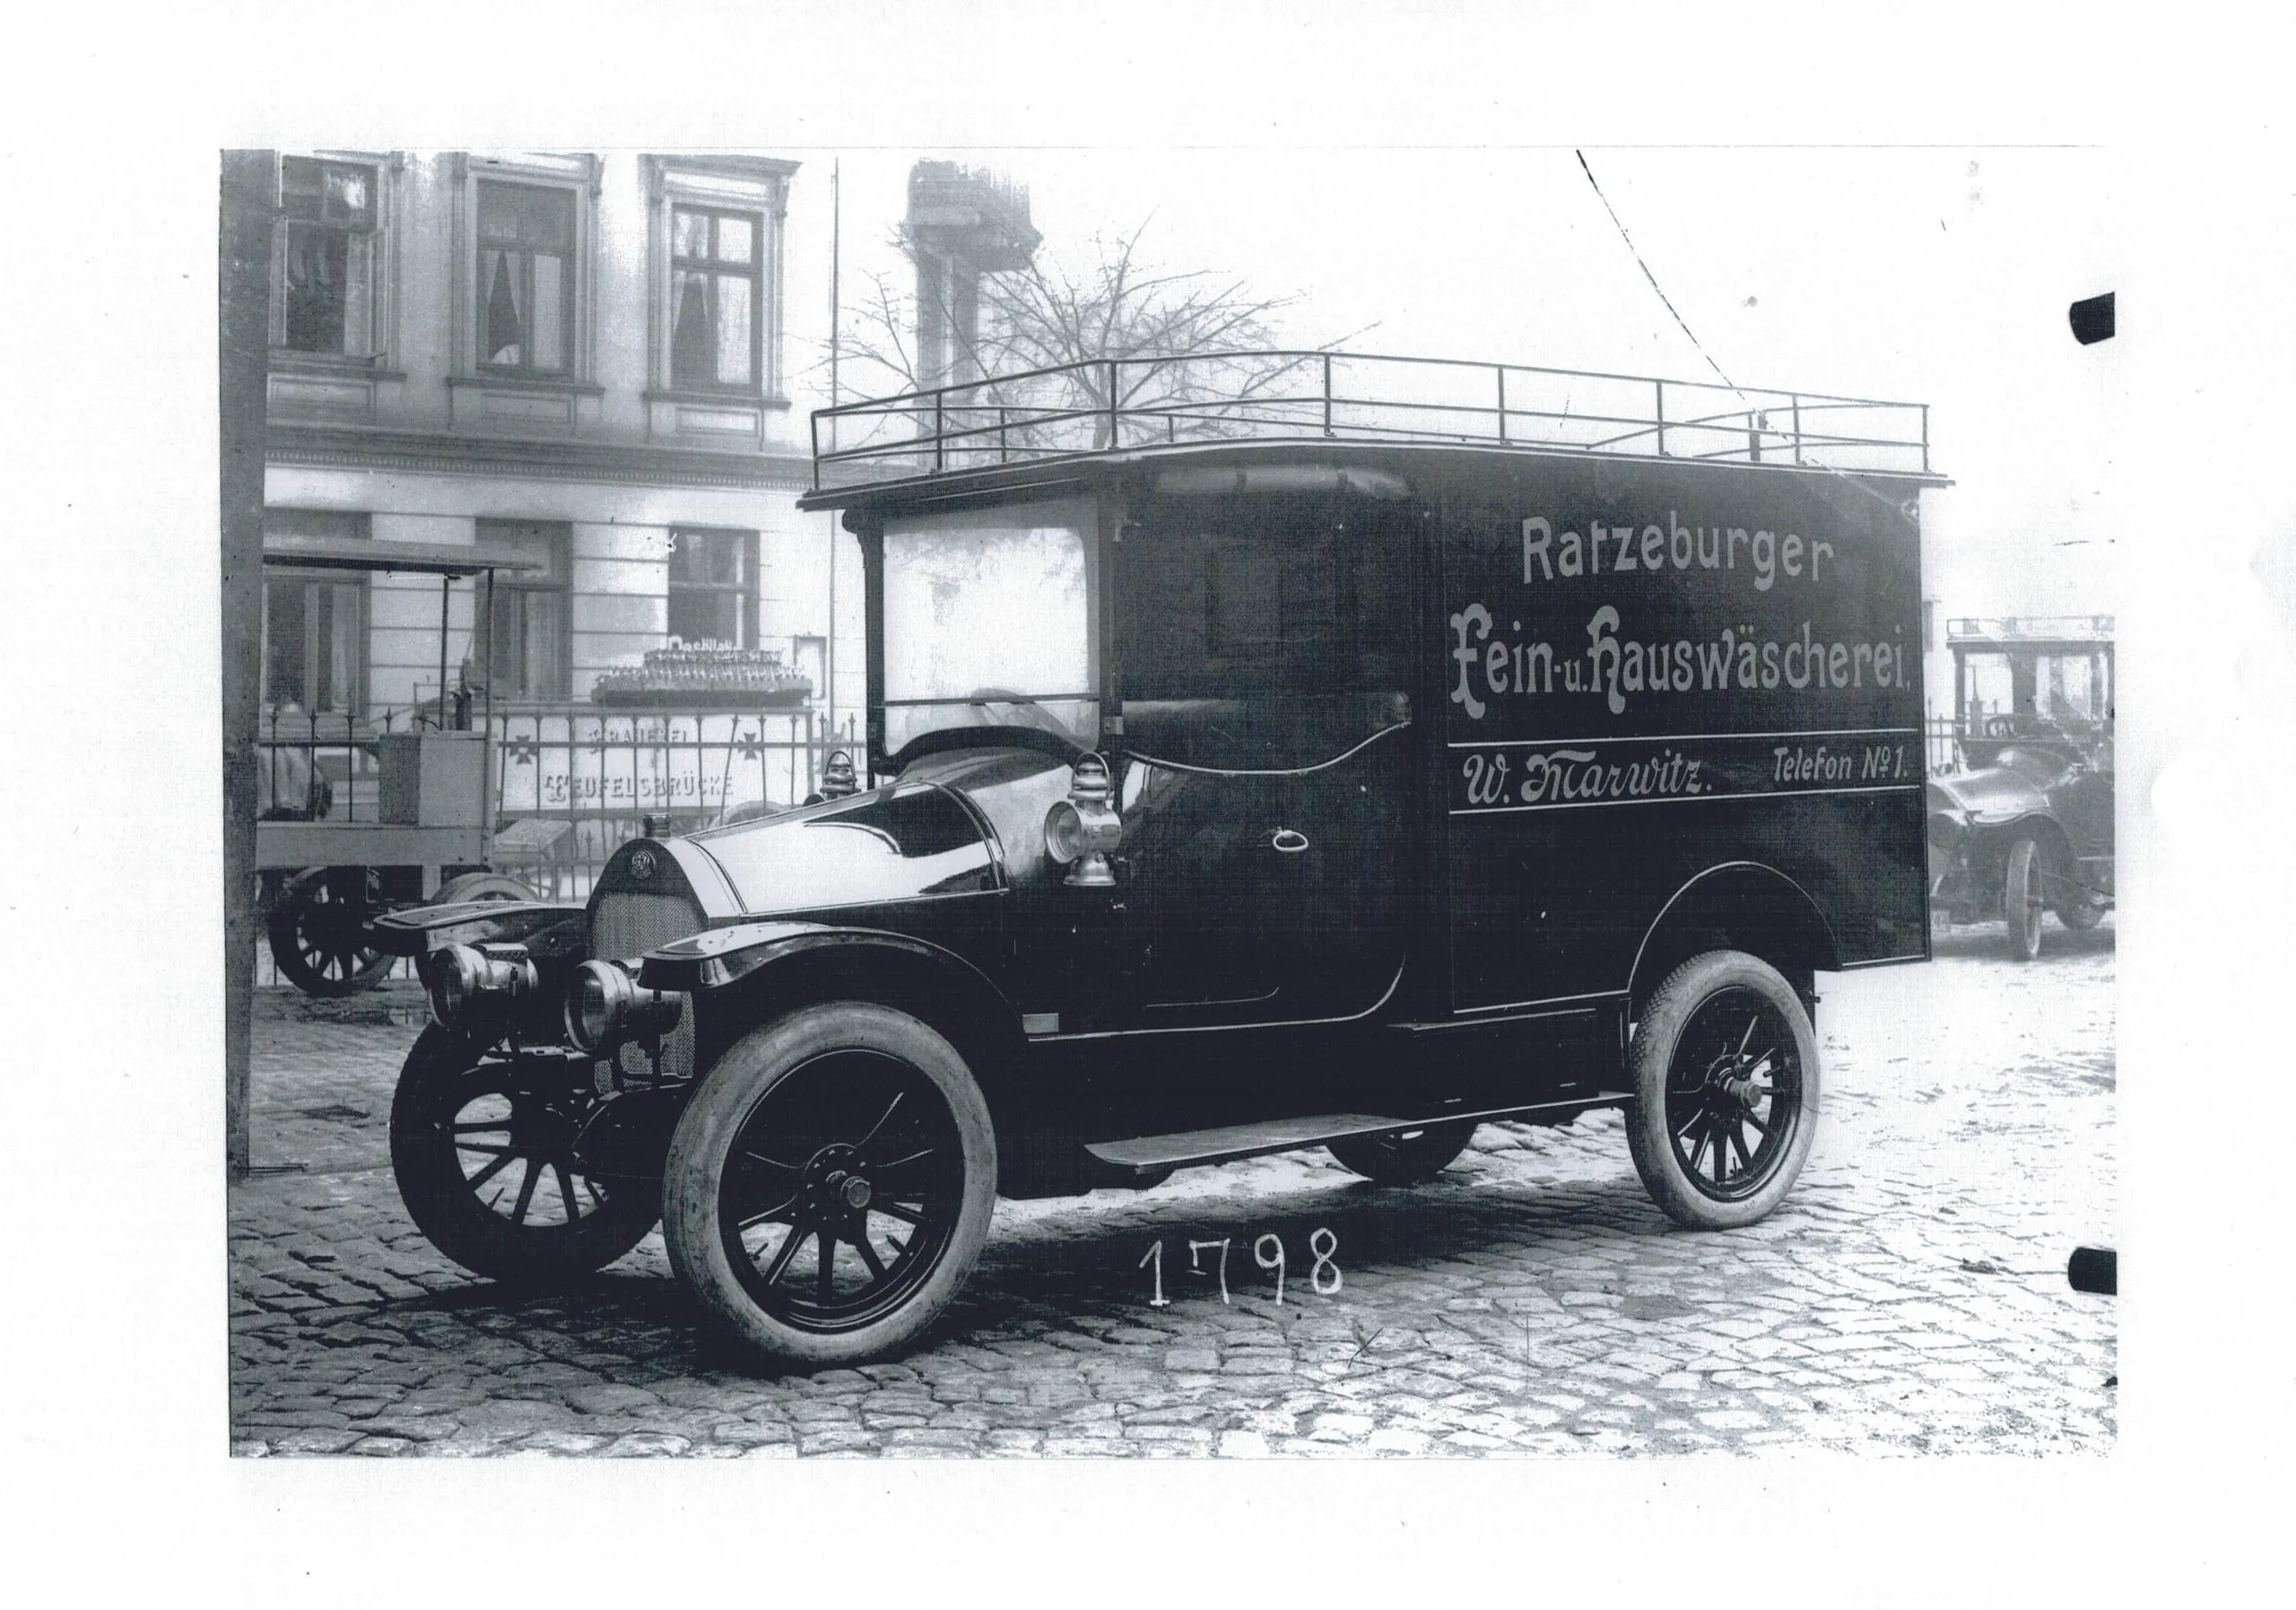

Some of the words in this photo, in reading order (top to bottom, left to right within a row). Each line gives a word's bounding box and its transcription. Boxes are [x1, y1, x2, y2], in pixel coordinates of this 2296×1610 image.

[1522, 510, 1834, 591] Ratzeburger
[1463, 753, 1510, 805] W.
[1520, 748, 1712, 803] Marwitz.
[1773, 746, 1853, 782] Telefon
